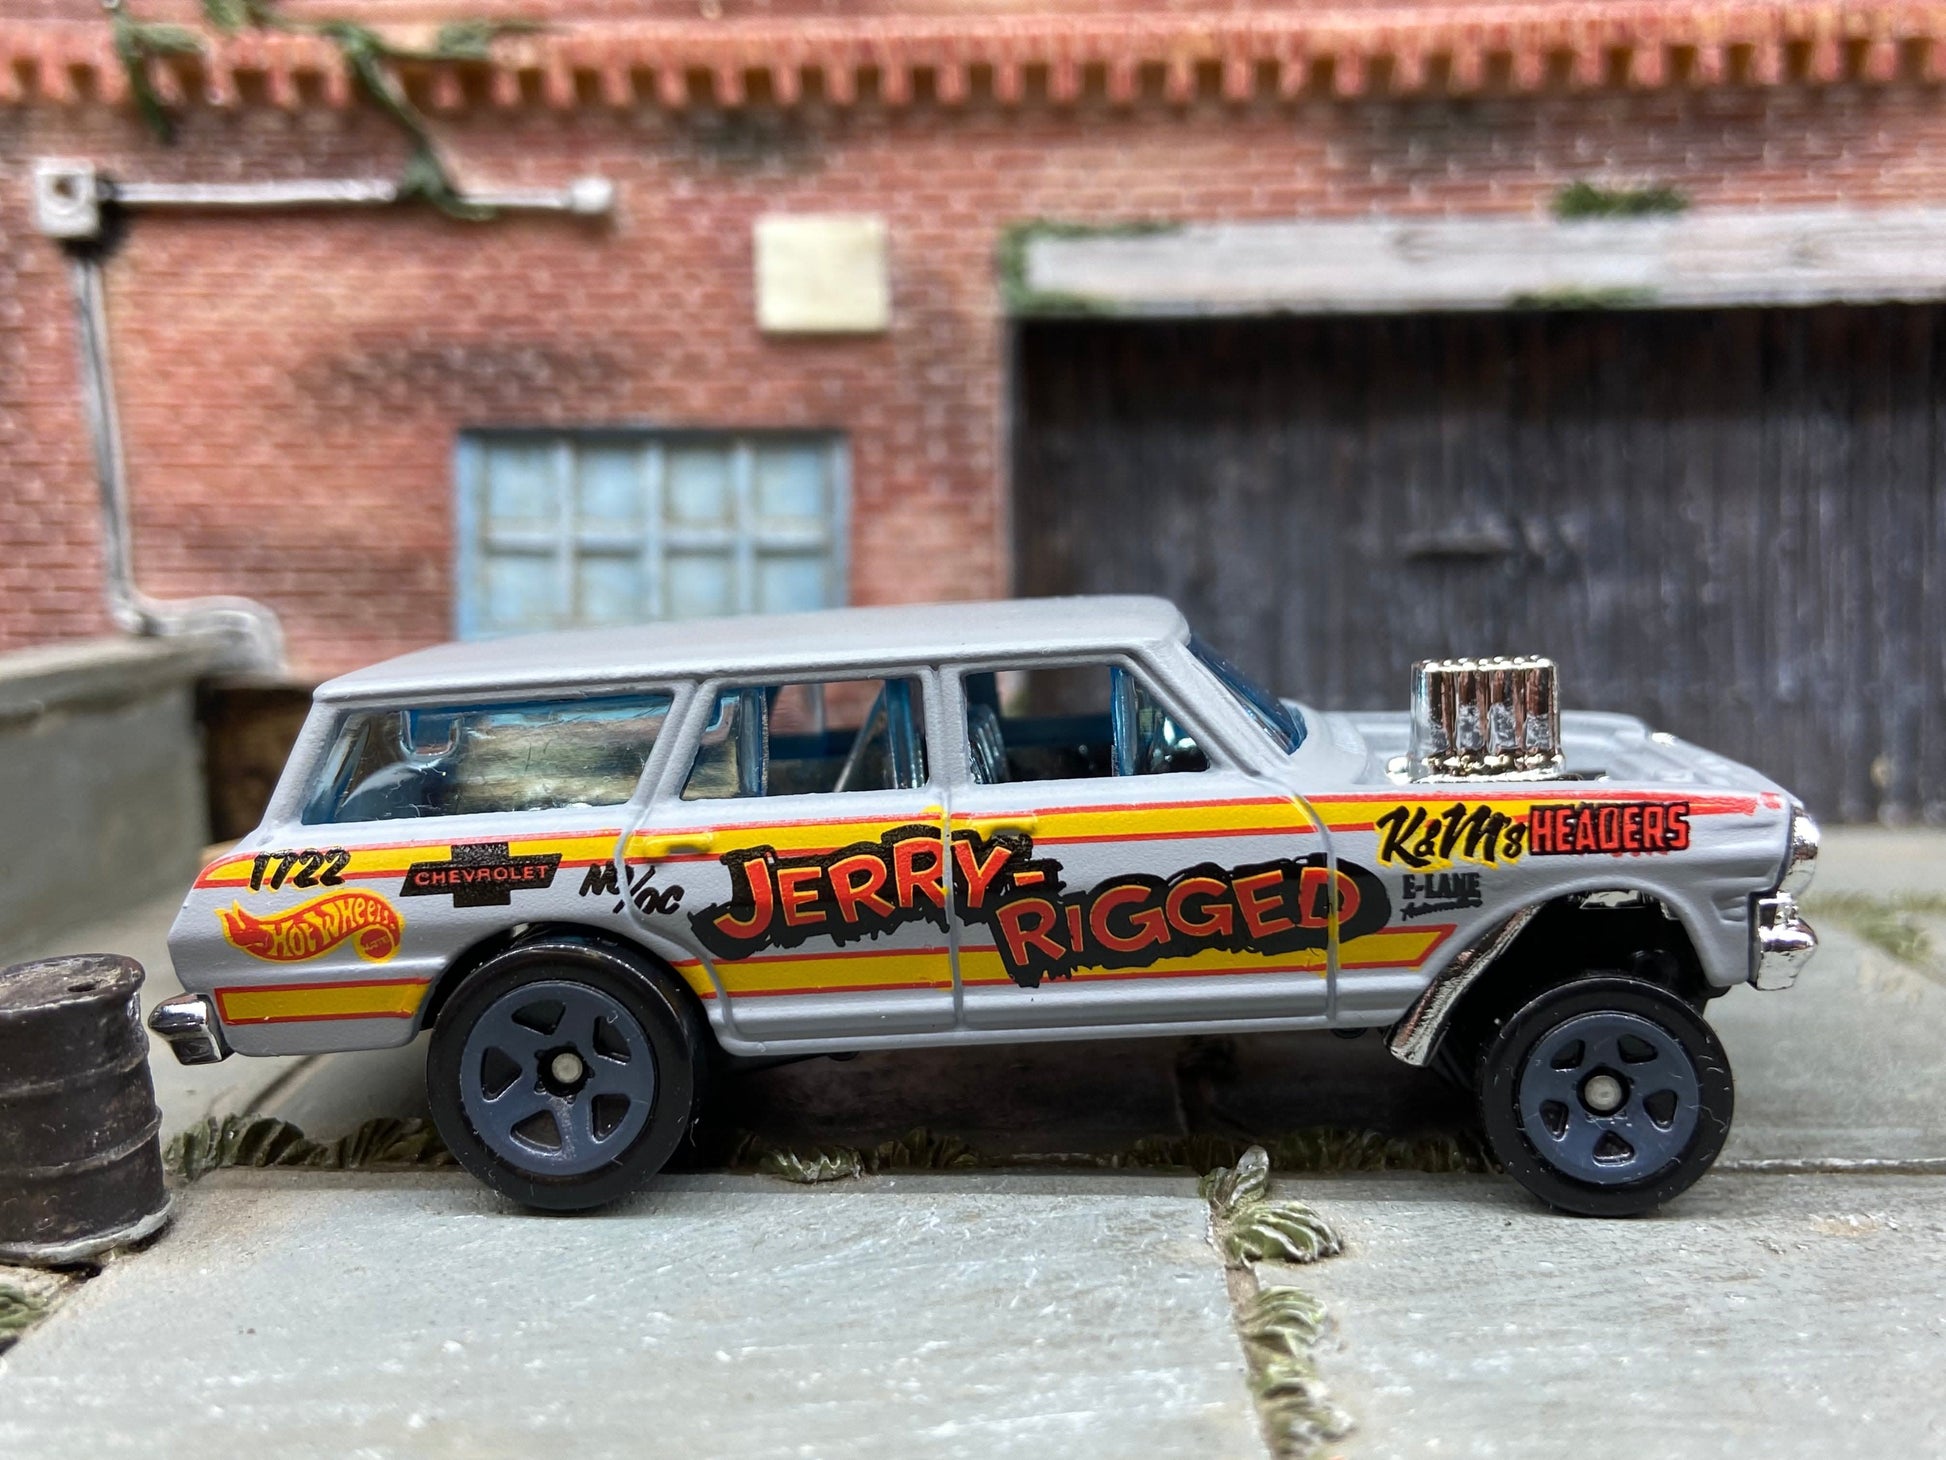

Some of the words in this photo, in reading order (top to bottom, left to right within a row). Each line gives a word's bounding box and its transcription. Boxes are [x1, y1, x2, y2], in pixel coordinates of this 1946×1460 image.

[1530, 803, 1690, 853] HEADERS
[250, 849, 352, 891] 1722
[414, 865, 549, 886] CHEVROLET
[1402, 872, 1482, 899] E-LANE
